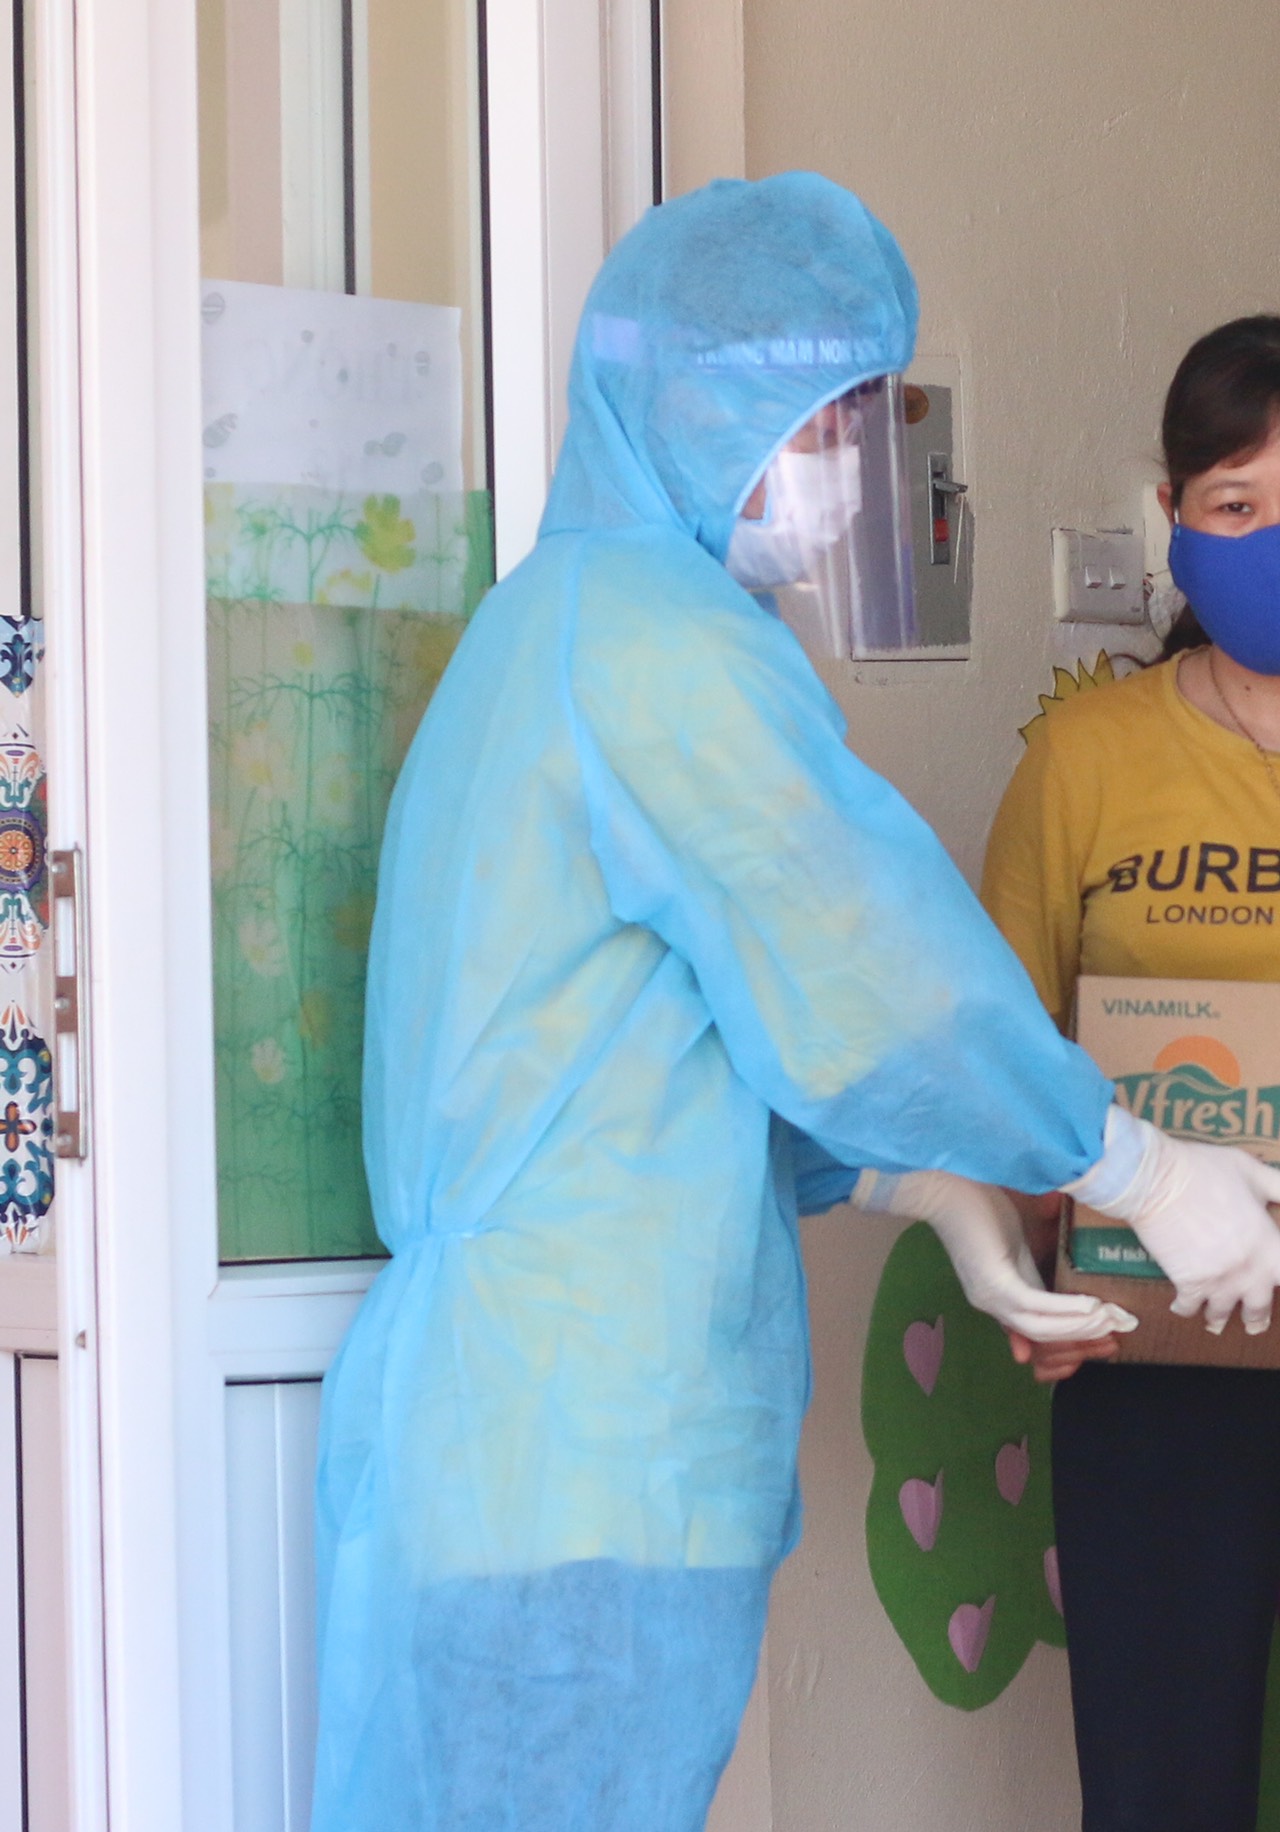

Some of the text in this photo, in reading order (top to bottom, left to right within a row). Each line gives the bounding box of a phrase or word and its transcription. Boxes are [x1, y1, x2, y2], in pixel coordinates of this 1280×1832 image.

[1146, 904, 1274, 926] LONDON
[1103, 999, 1213, 1018] VINAMILK
[1114, 1079, 1274, 1138] Vfresh
